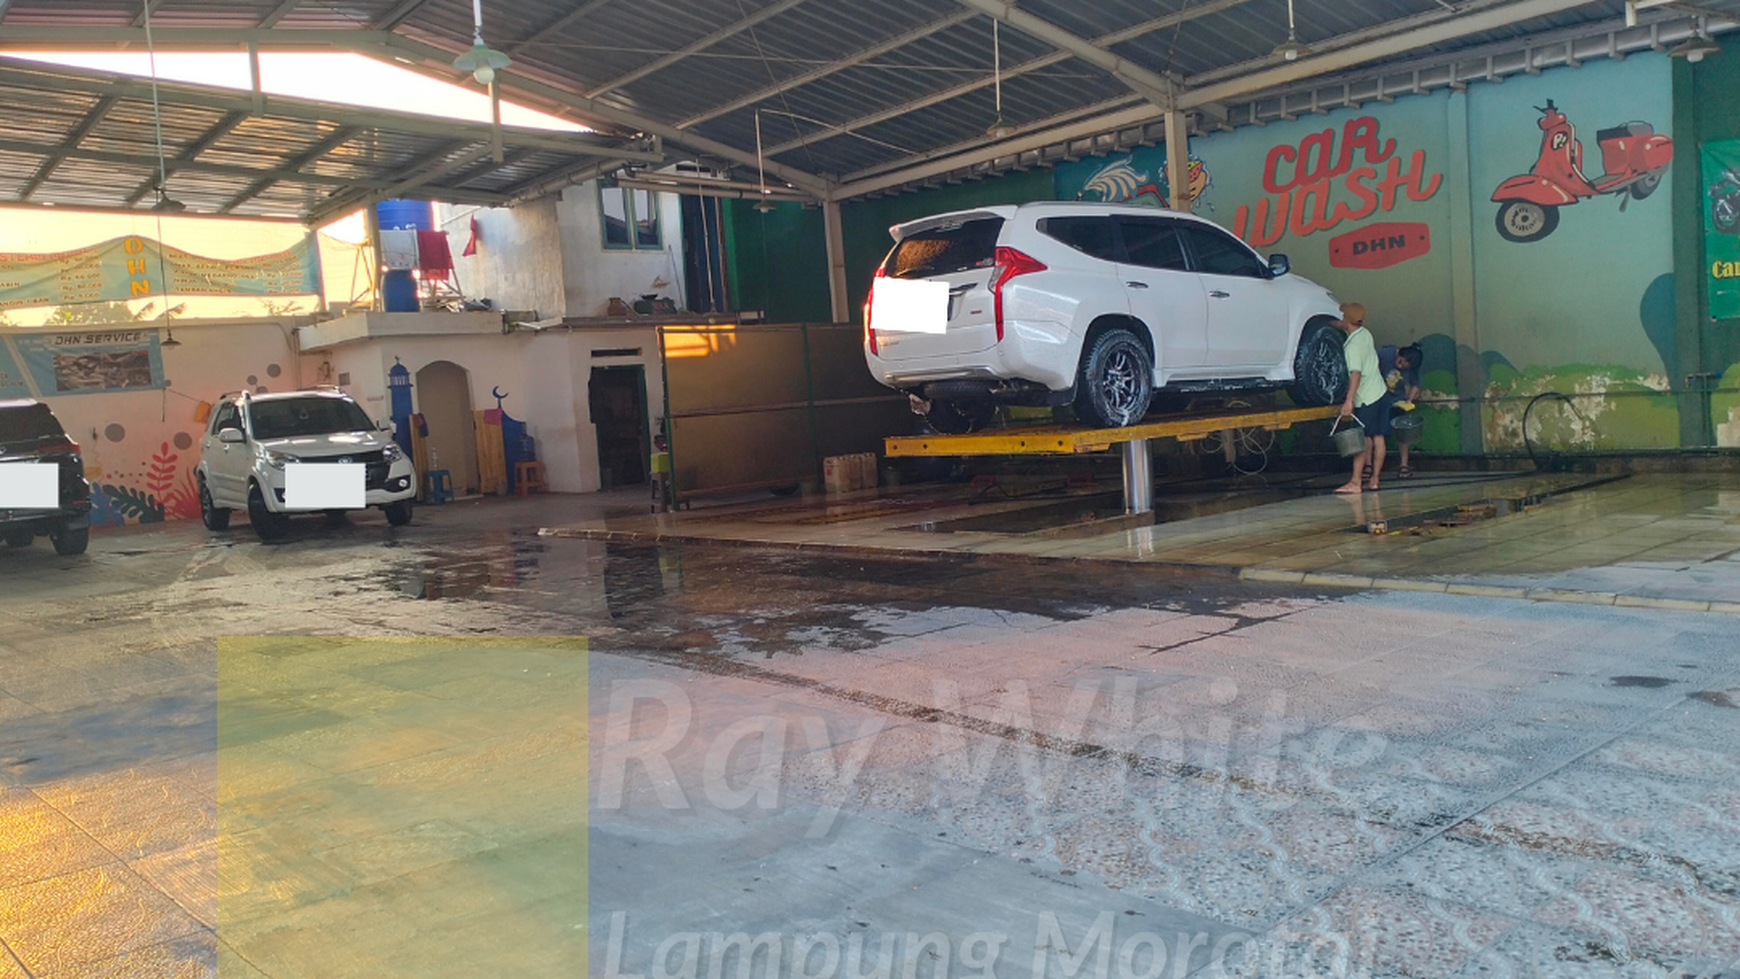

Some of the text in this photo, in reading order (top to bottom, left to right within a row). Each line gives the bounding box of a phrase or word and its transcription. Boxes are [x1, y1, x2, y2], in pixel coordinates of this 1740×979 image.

[1352, 234, 1406, 255] DHN
[123, 237, 151, 298] DHN
[54, 335, 82, 346] DHN
[83, 332, 142, 345] SERVICE
